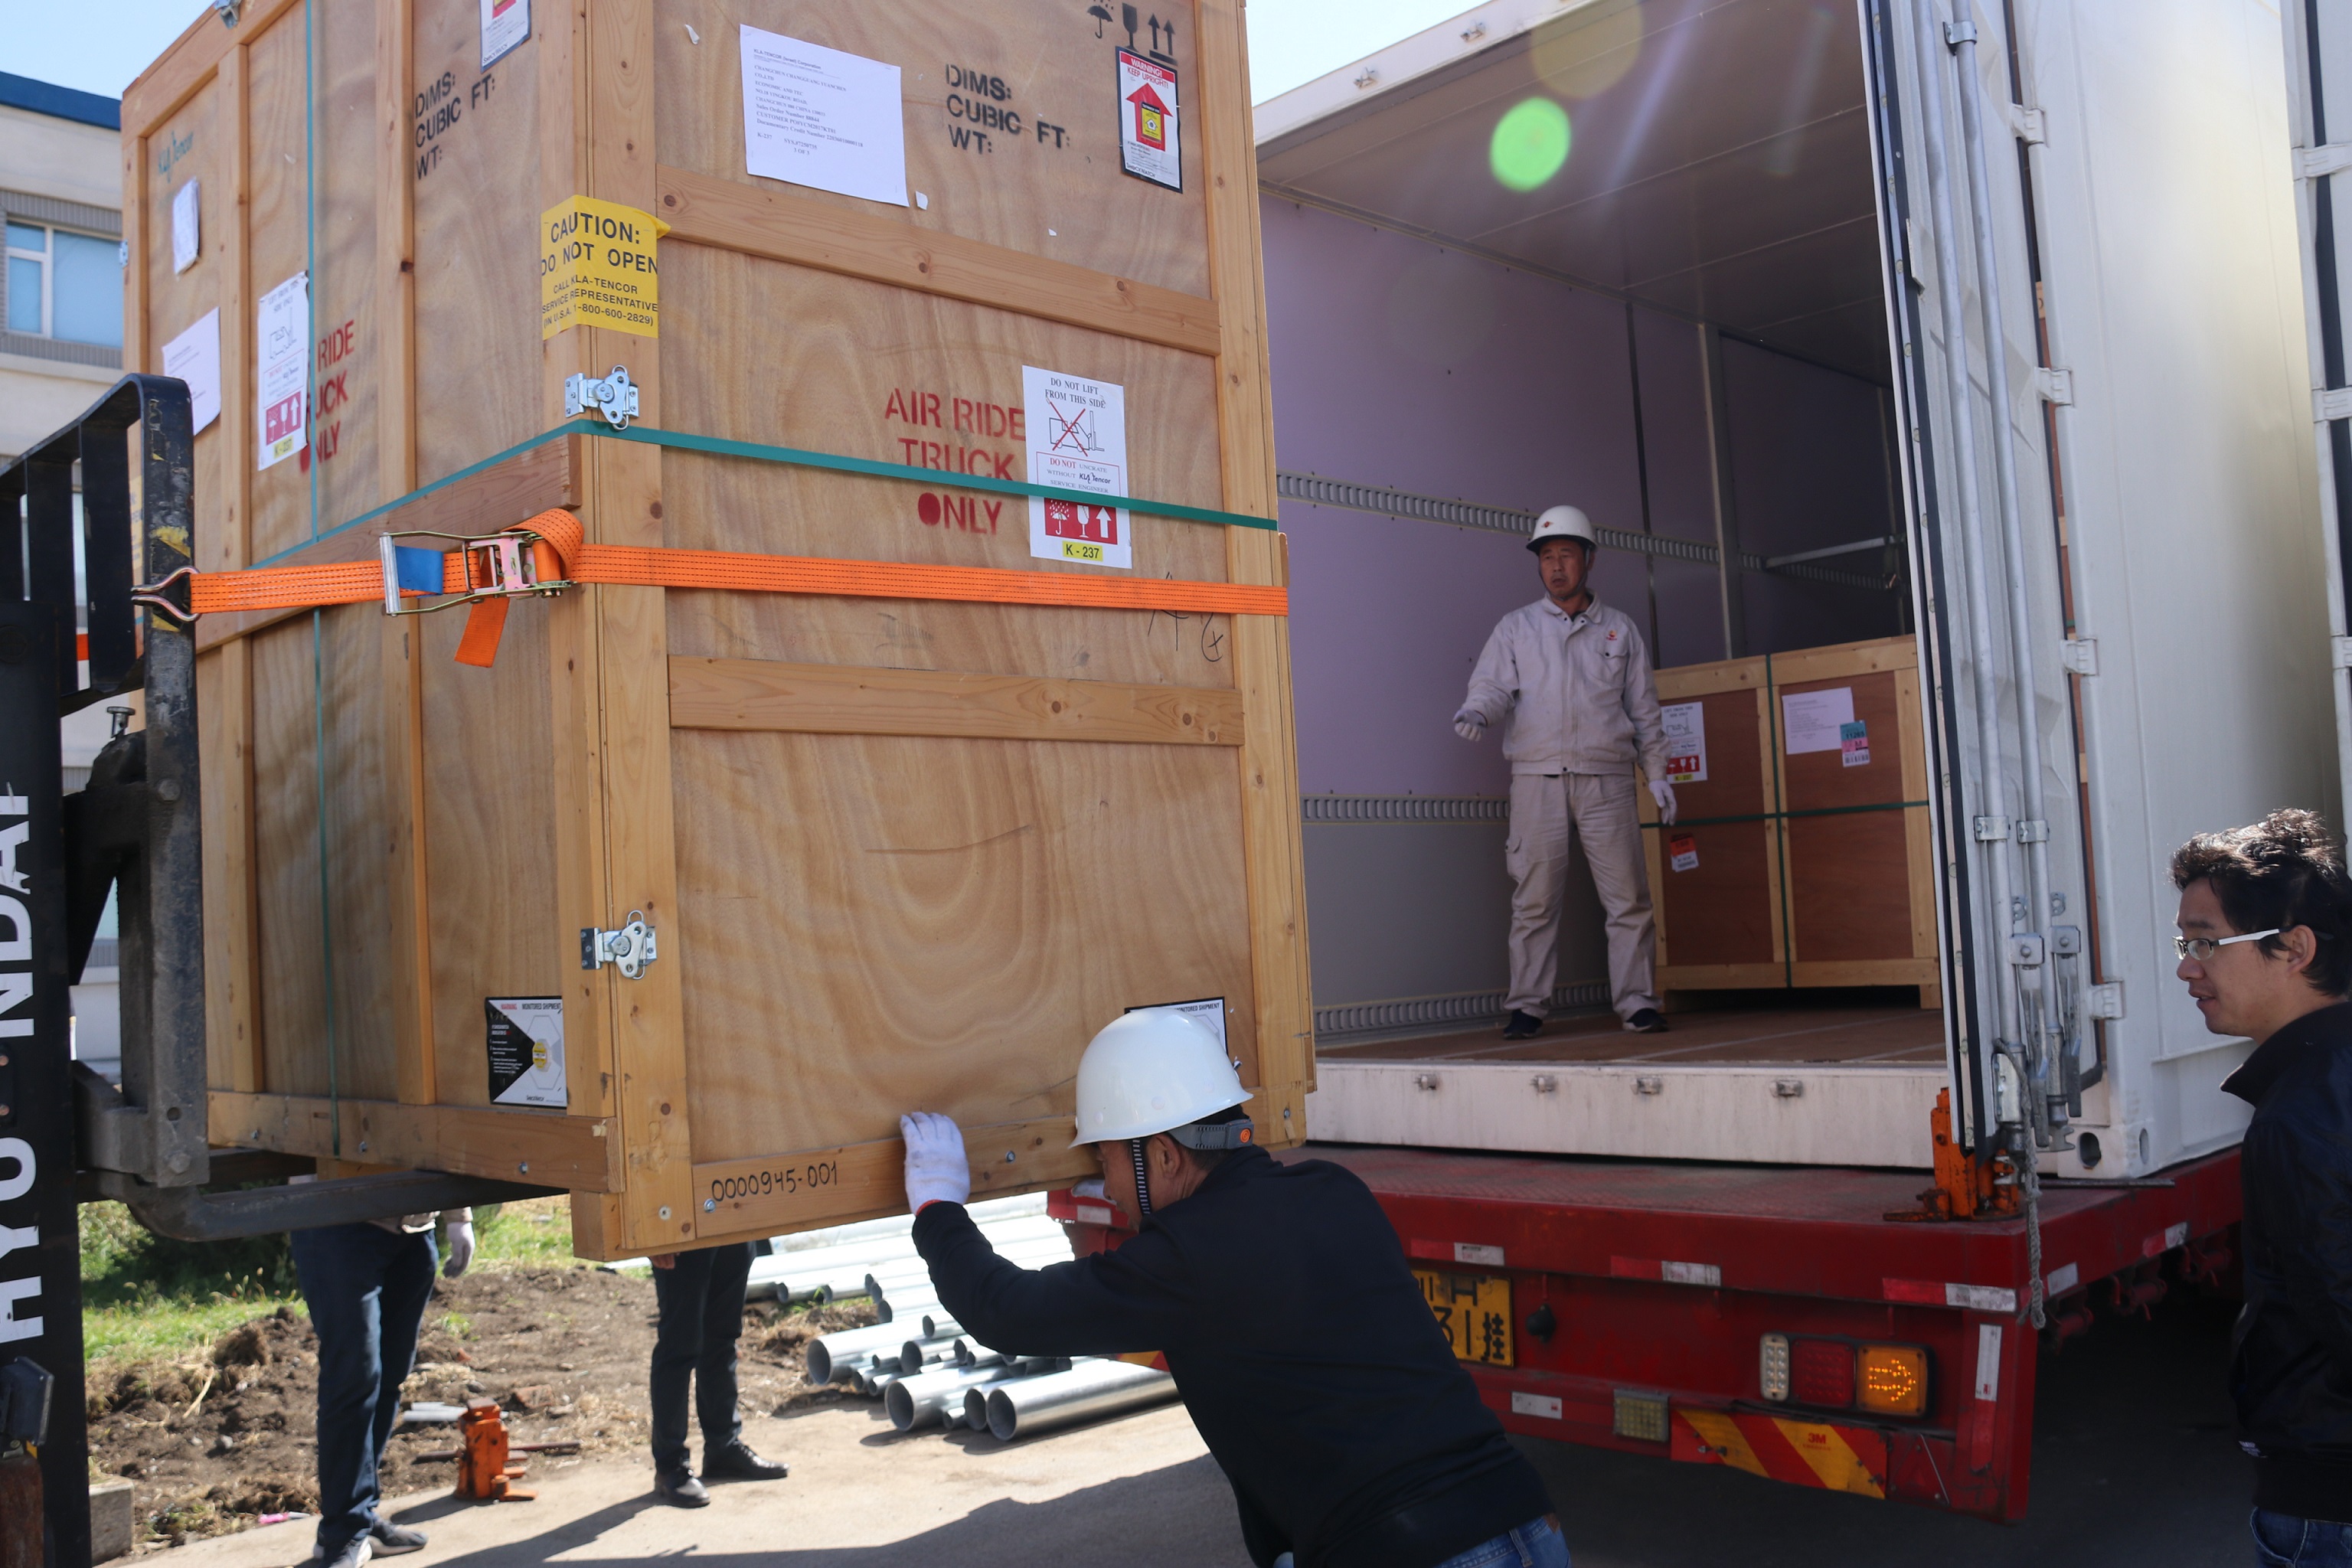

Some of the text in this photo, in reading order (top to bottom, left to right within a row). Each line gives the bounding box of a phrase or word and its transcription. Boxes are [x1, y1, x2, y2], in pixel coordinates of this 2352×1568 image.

[1127, 66, 1169, 90] KEEP UPRIGHT!
[1131, 58, 1162, 77] WARNING!
[415, 71, 456, 119] DIMS:
[945, 64, 1012, 102] DIMS:
[416, 74, 495, 148] CUBIC FT:
[946, 94, 1071, 149] CUBIC FT:
[948, 125, 993, 155] WT:
[416, 145, 443, 180] WT:
[550, 211, 640, 244] CAUTION:
[541, 241, 658, 276] DO NOT OPEN
[553, 275, 638, 295] CALL KLA-TENCOR
[542, 289, 658, 314] SERVICE REPRESENTATIVE
[543, 304, 653, 330] (IN U.S.A. 1-800-600-2829)
[318, 319, 354, 372] RIDE
[1045, 389, 1106, 409] FROM THIS SIDE
[1050, 377, 1099, 394] DO NOT LIFT
[884, 387, 1026, 442] AIR RIDE
[897, 438, 1015, 482] TRUCK
[1047, 469, 1076, 479] WITHOUT
[1050, 457, 1108, 473] DO NOT UNCRATE
[1050, 479, 1109, 494] SERVICE ENGINEER
[917, 492, 1003, 536] ONLY
[1199, 1002, 1220, 1011] SHIPMENT
[711, 1161, 838, 1202] 0000945-001
[1808, 1432, 1827, 1444] 3M
